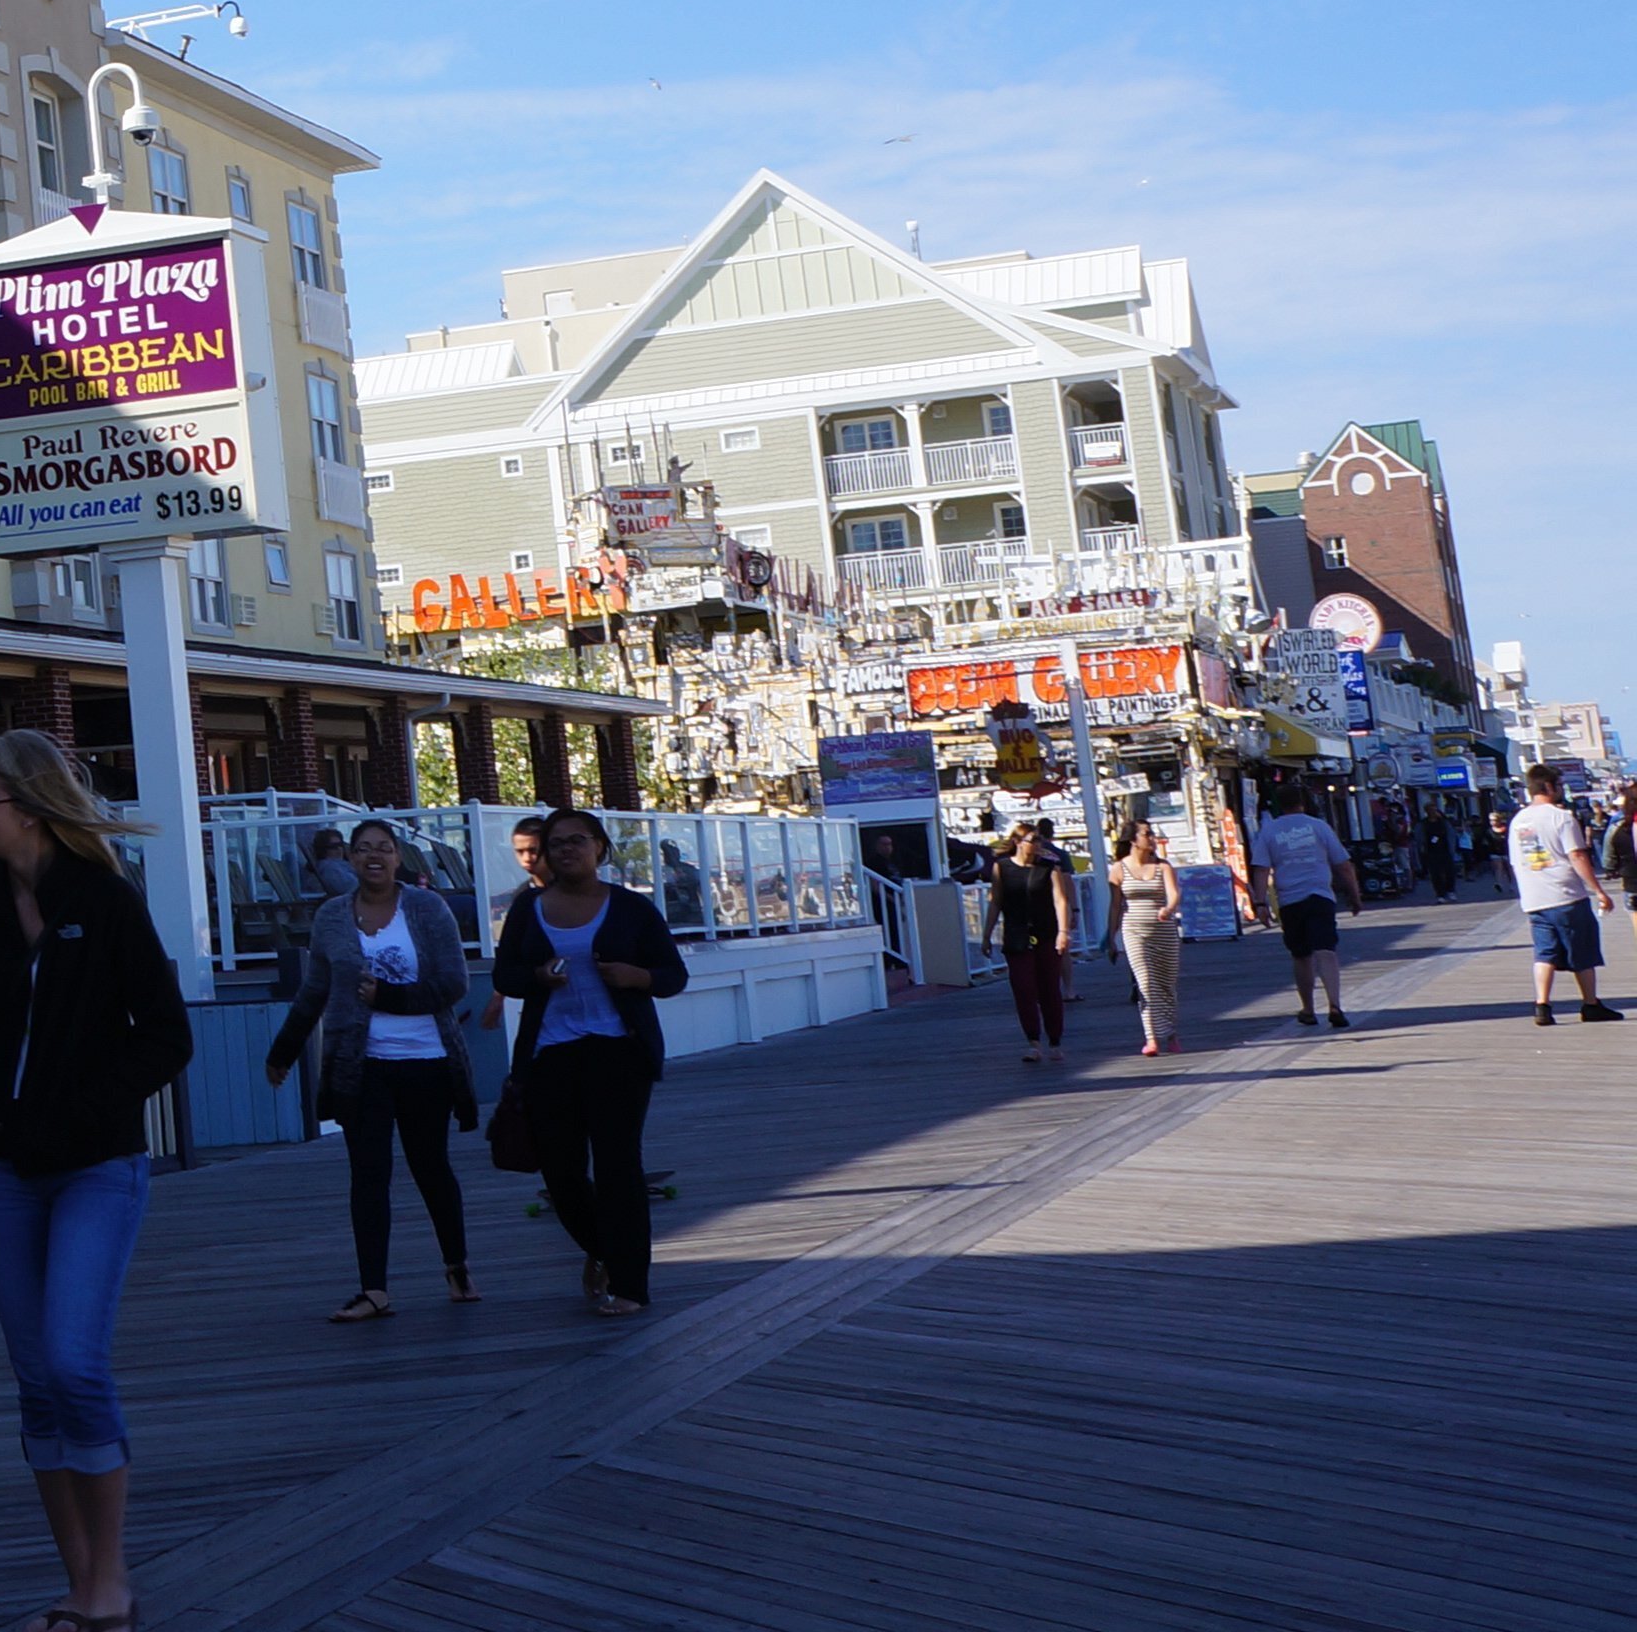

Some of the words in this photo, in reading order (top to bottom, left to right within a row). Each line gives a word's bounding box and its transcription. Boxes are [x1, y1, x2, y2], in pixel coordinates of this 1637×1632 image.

[86, 258, 219, 304] Plaza
[31, 303, 168, 346] HOTEL
[29, 384, 68, 407] POOL
[76, 379, 109, 401] BAR
[116, 377, 129, 397] &
[135, 369, 181, 394] GRILL
[22, 429, 83, 459] Paul
[99, 422, 198, 450] Revere
[29, 506, 65, 530] you
[70, 499, 106, 520] can
[109, 494, 142, 513] eat
[156, 485, 243, 520] $13.99
[617, 515, 670, 535] GALLERY
[1082, 591, 1144, 611] SALE!
[836, 665, 904, 694] FAMOUS
[1285, 653, 1338, 673] WORLD
[908, 660, 1020, 714] OCEAN
[1033, 646, 1181, 704] GLLERY
[1109, 696, 1178, 715] PAINTINGS
[1307, 687, 1329, 712] &
